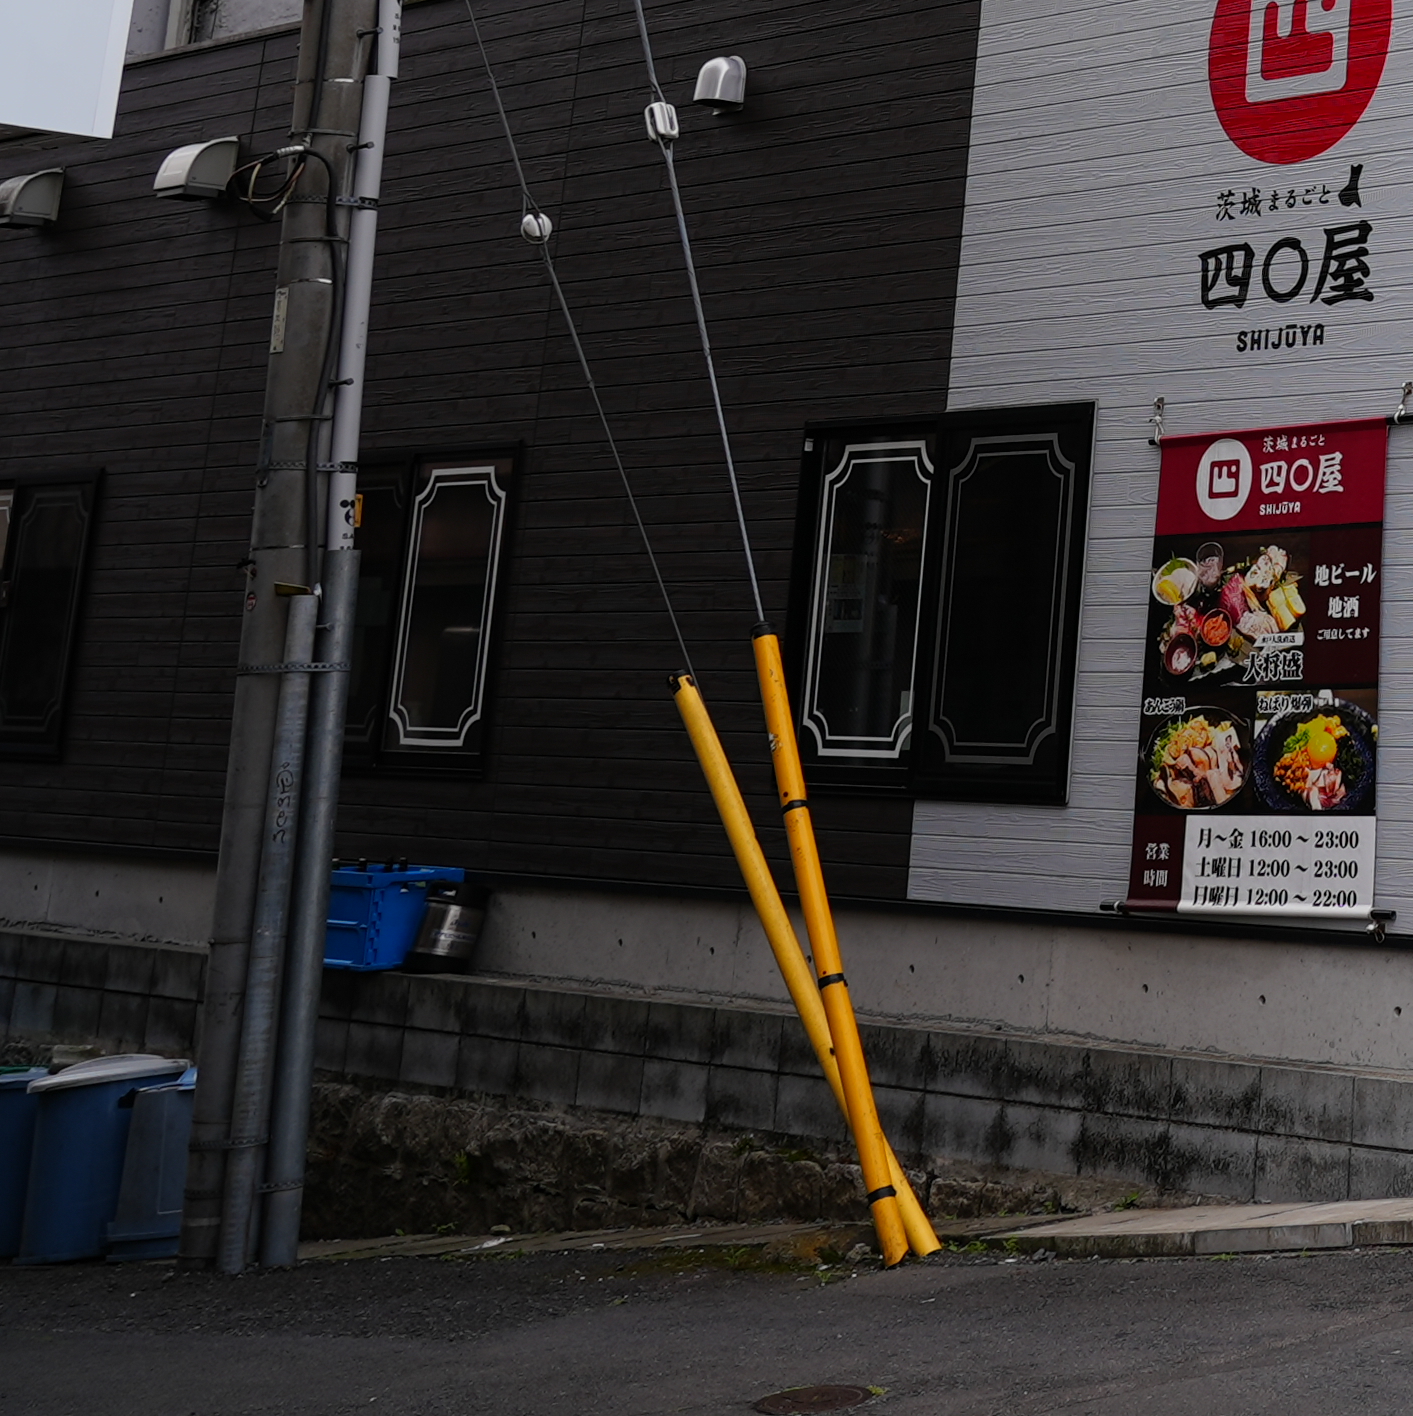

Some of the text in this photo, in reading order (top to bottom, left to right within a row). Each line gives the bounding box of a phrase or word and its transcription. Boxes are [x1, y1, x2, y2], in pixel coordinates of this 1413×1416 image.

[1215, 182, 1332, 222] 茨城まるごと
[1262, 433, 1326, 454] 茨城まるごと
[1313, 562, 1376, 588] 地ビール
[1327, 595, 1360, 620] 地酒
[1316, 627, 1370, 641] ご用意してます
[1242, 650, 1303, 684] 大将盛
[1197, 828, 1245, 850] 月〜金
[1249, 828, 1292, 849] 16:00
[1314, 827, 1359, 850] 23:00
[1145, 842, 1170, 861] 営業
[1143, 868, 1168, 887] 時間
[1194, 857, 1241, 879] 土曜日
[1248, 857, 1290, 878] 12:00
[1312, 858, 1358, 880] 23:00
[1192, 885, 1239, 908] 日曜日
[1246, 887, 1288, 907] 12:00
[1311, 887, 1358, 909] 22:00
